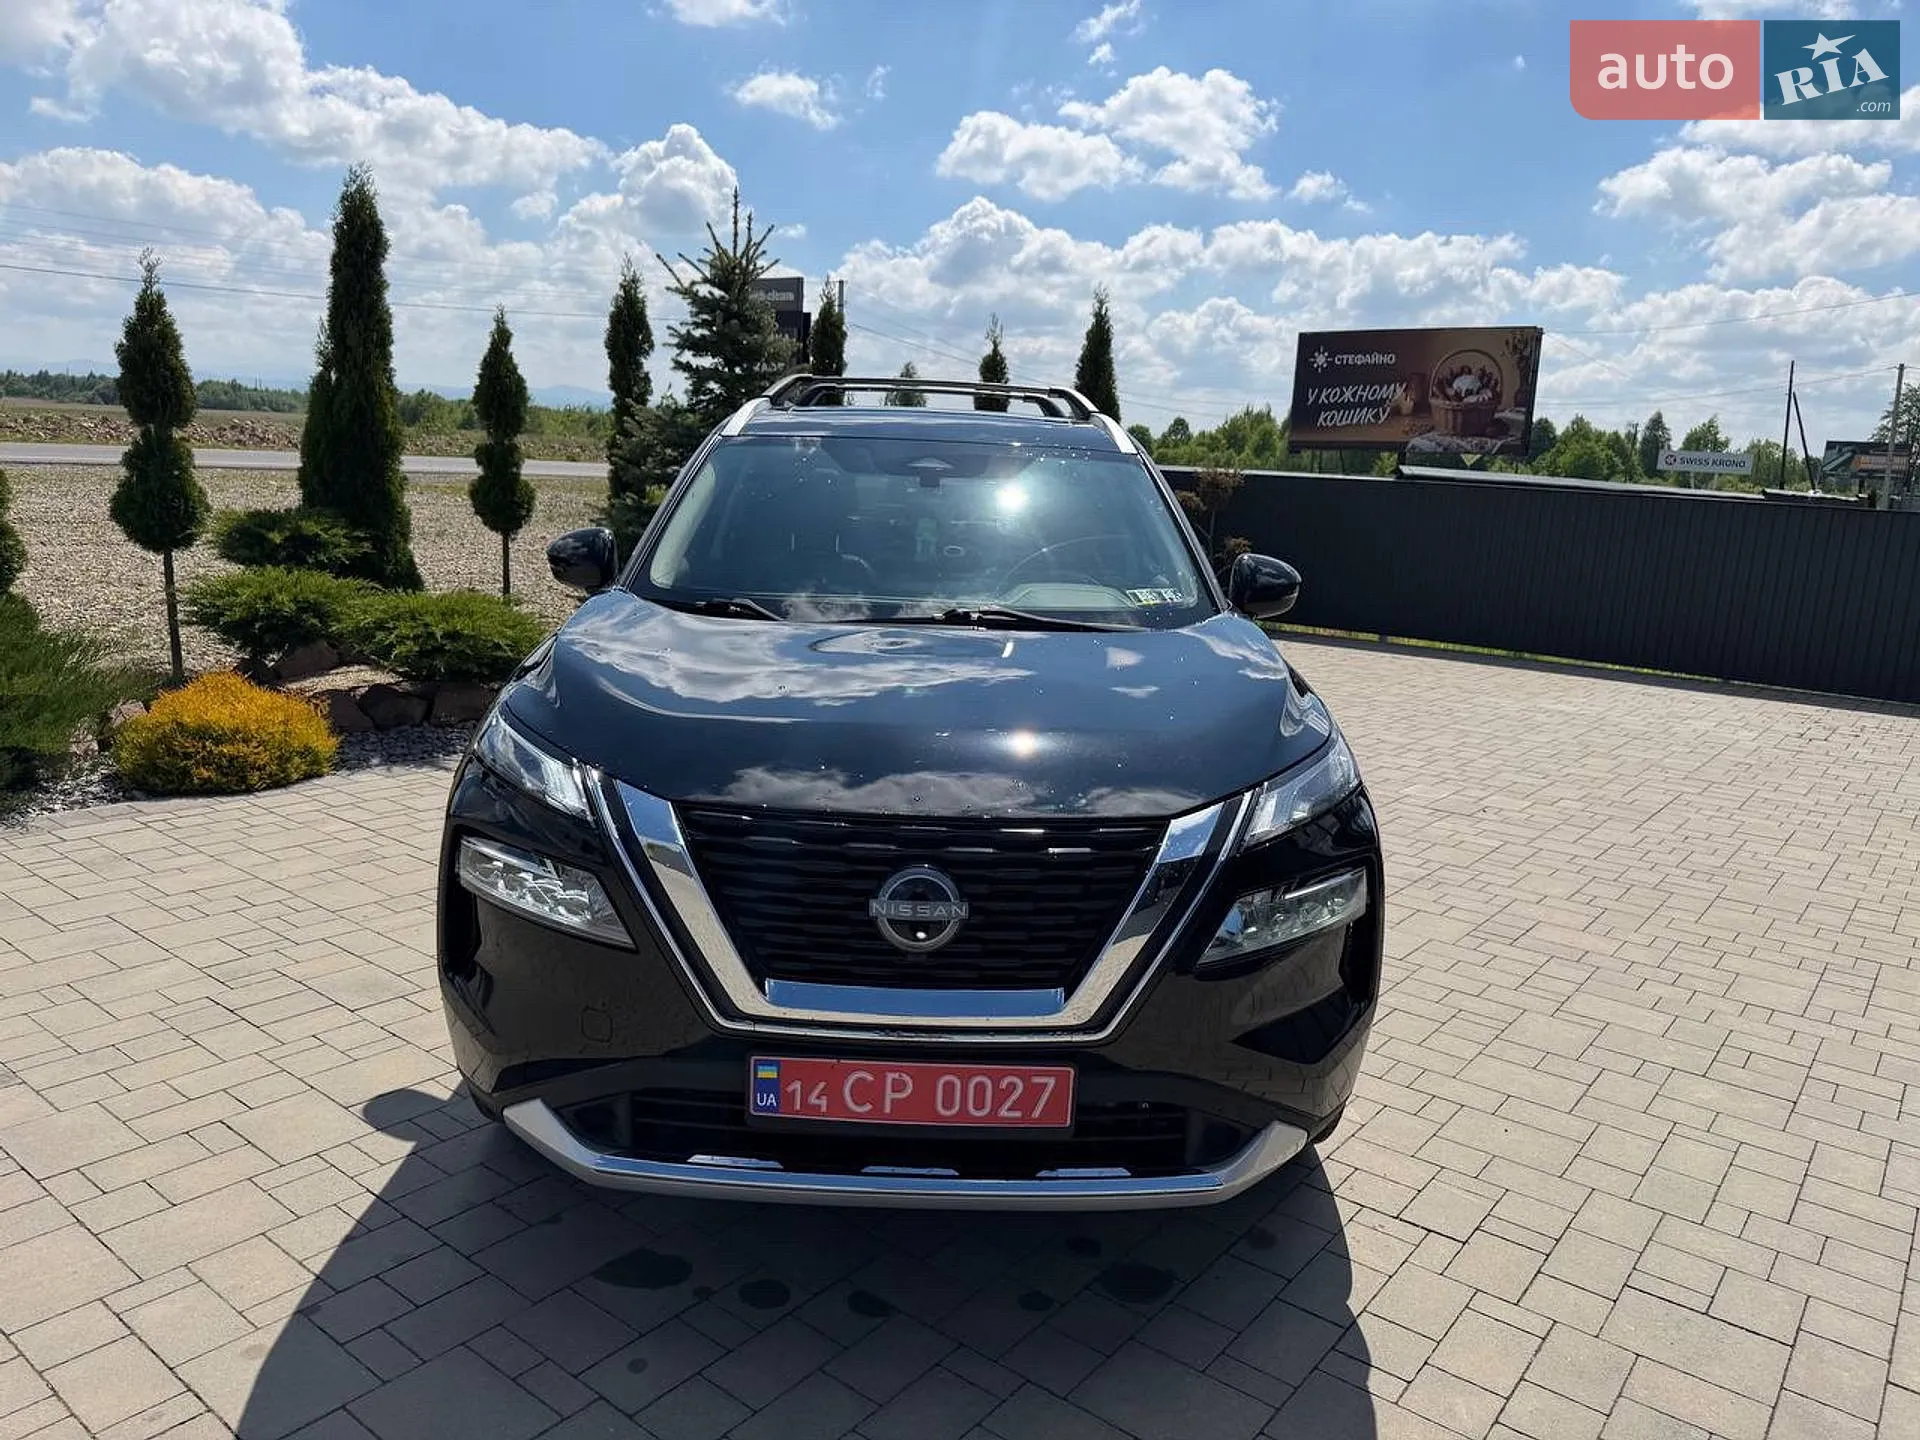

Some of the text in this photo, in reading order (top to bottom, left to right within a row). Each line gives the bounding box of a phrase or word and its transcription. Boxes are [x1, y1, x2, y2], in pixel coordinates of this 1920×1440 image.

[1335, 351, 1396, 365] СТЕФАЙНО
[1319, 382, 1407, 404] КОЖНОМУ
[1317, 407, 1391, 426] КОШИКУ
[1680, 456, 1710, 467] SWISS
[872, 902, 966, 917] NISSAN
[757, 1093, 777, 1107] UA
[936, 1074, 1057, 1119] 0027
